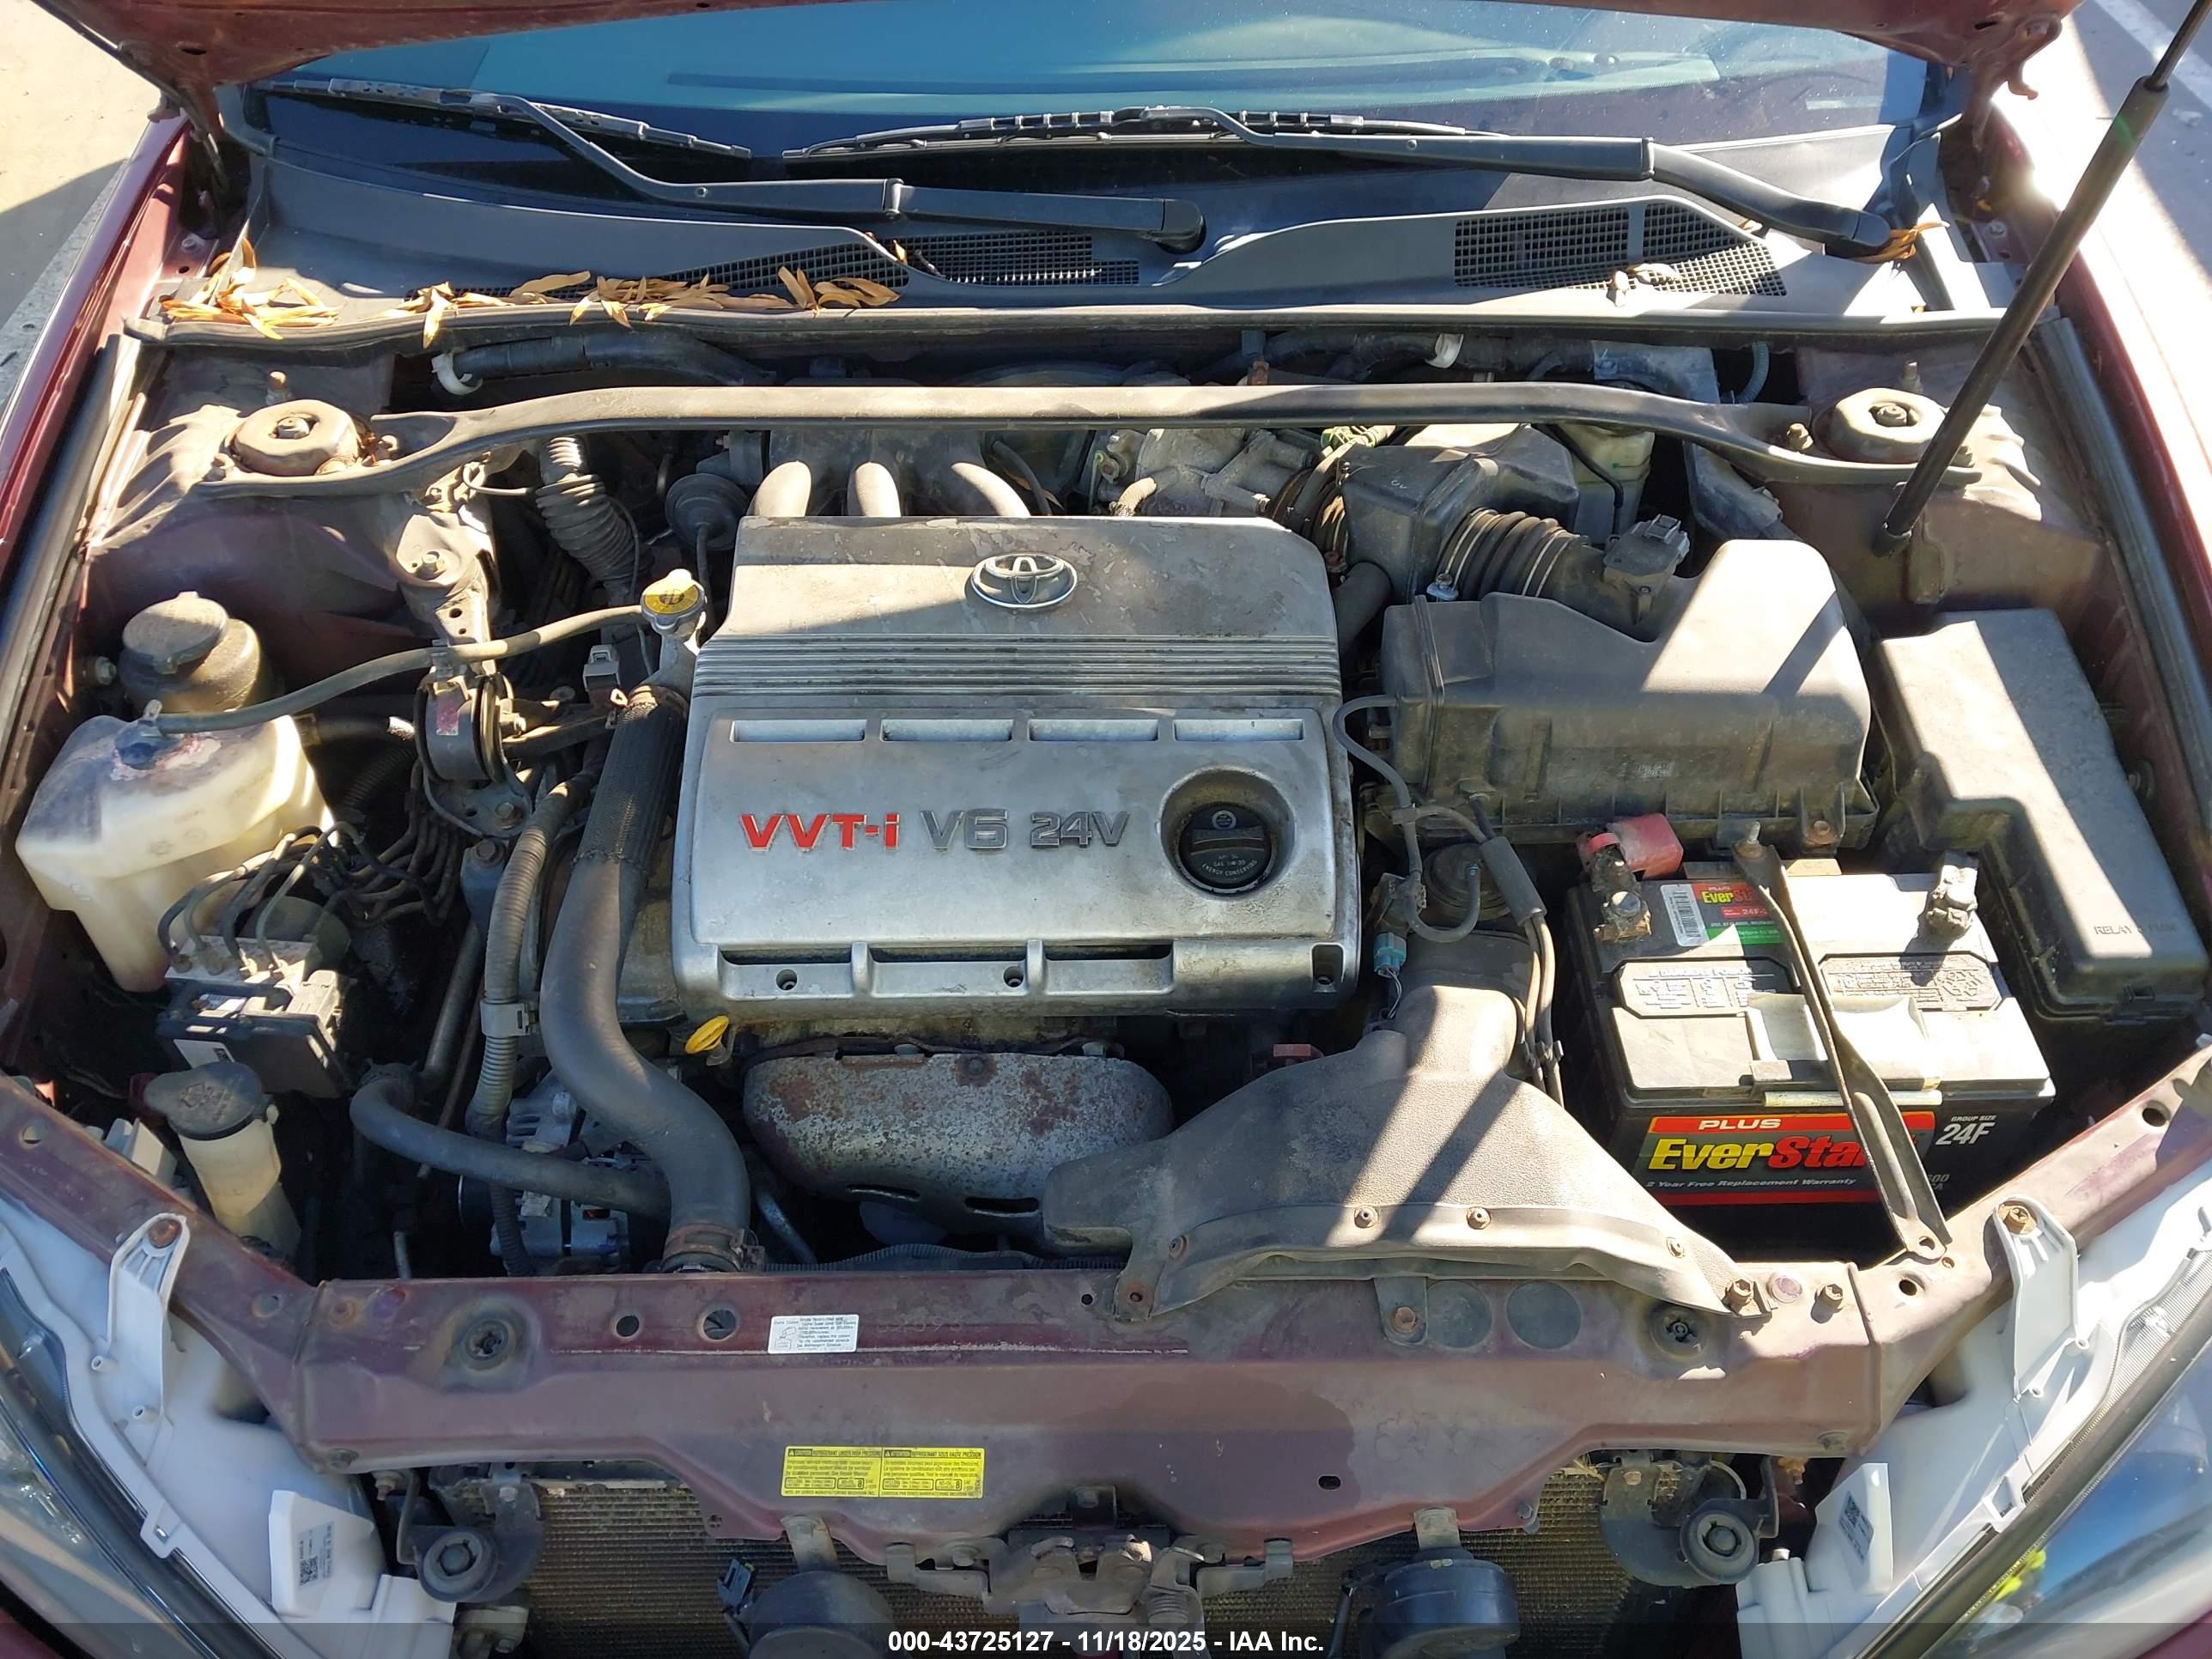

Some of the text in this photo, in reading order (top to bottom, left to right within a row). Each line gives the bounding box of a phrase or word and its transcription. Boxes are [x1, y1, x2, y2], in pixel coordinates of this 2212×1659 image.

[739, 811, 1131, 852] VVT-i V6 24V
[2094, 925, 2133, 934] RELAY
[1698, 1119, 1783, 1131] PLUS
[1936, 1122, 1996, 1146] 24F
[1648, 1135, 1869, 1170] EverSta
[1717, 1179, 1799, 1188] Replacement
[1802, 1177, 1856, 1187] Warranty
